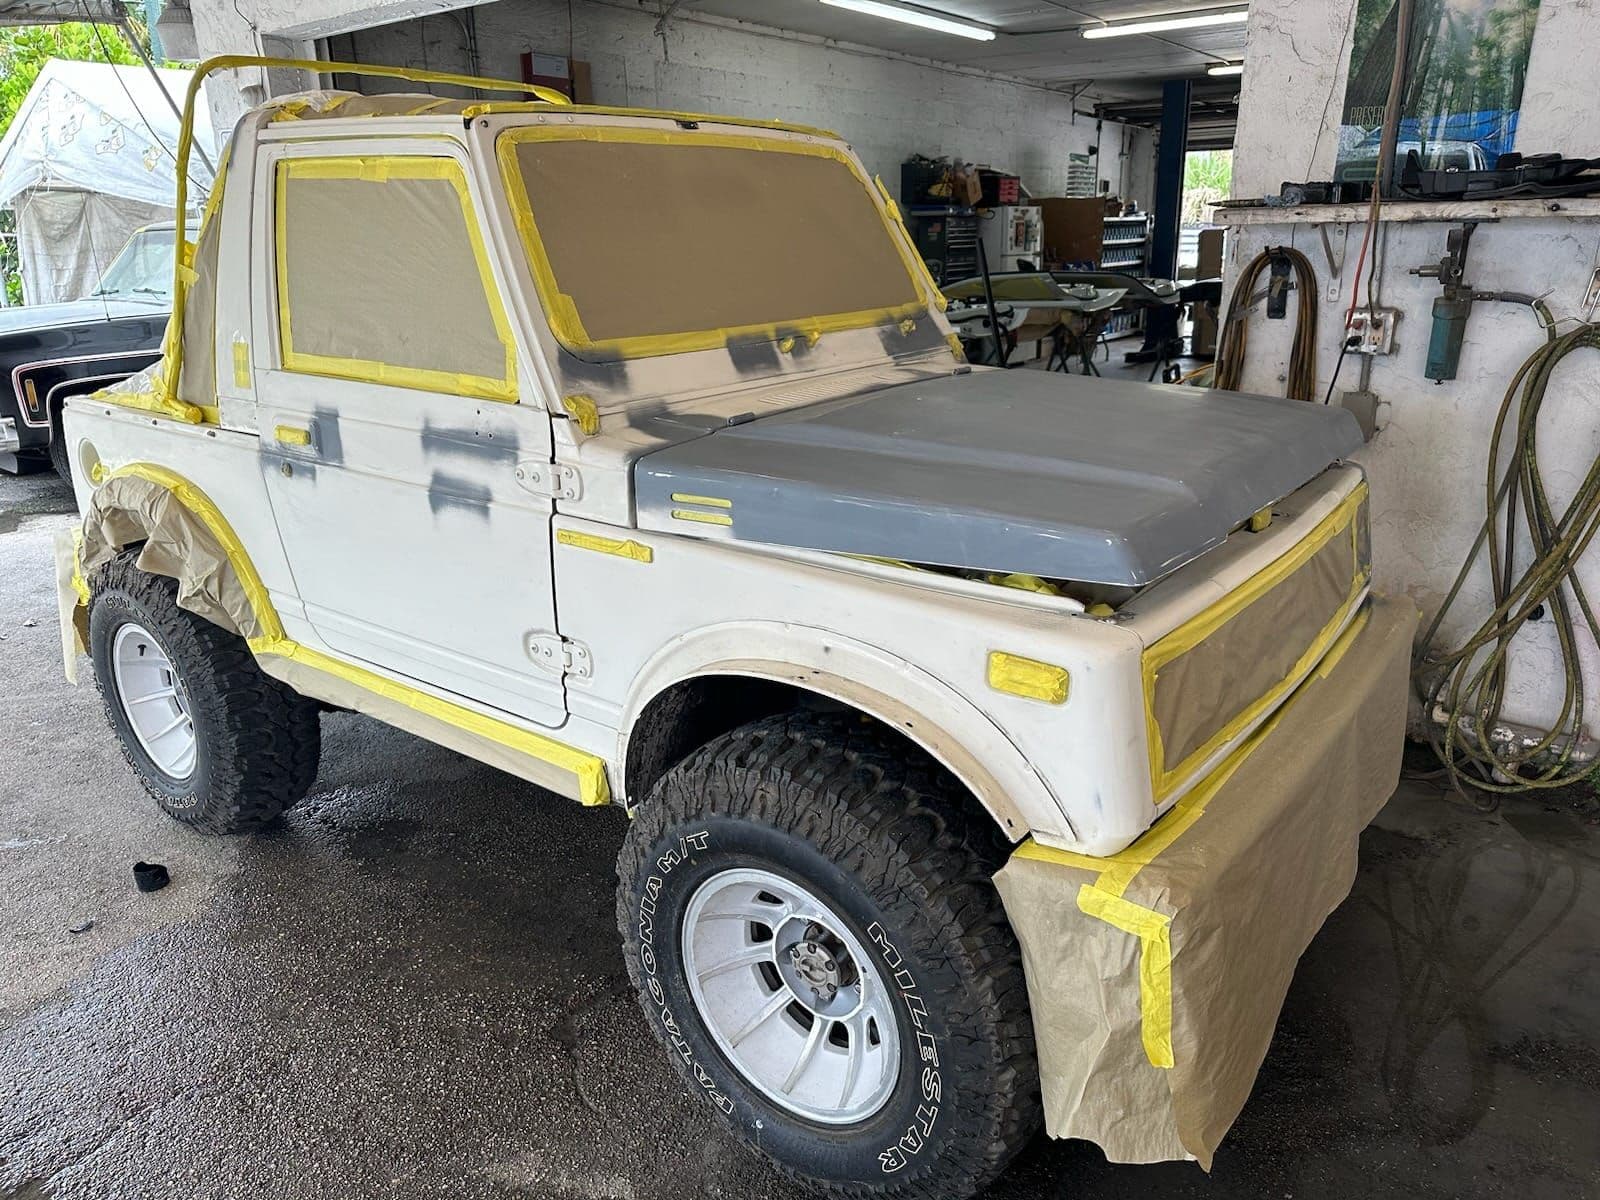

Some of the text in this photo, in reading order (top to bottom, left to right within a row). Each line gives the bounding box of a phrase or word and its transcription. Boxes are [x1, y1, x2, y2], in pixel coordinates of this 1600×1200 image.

[638, 830, 735, 1115] PATAGONIA M/T
[866, 920, 942, 1174] MILESTAR
